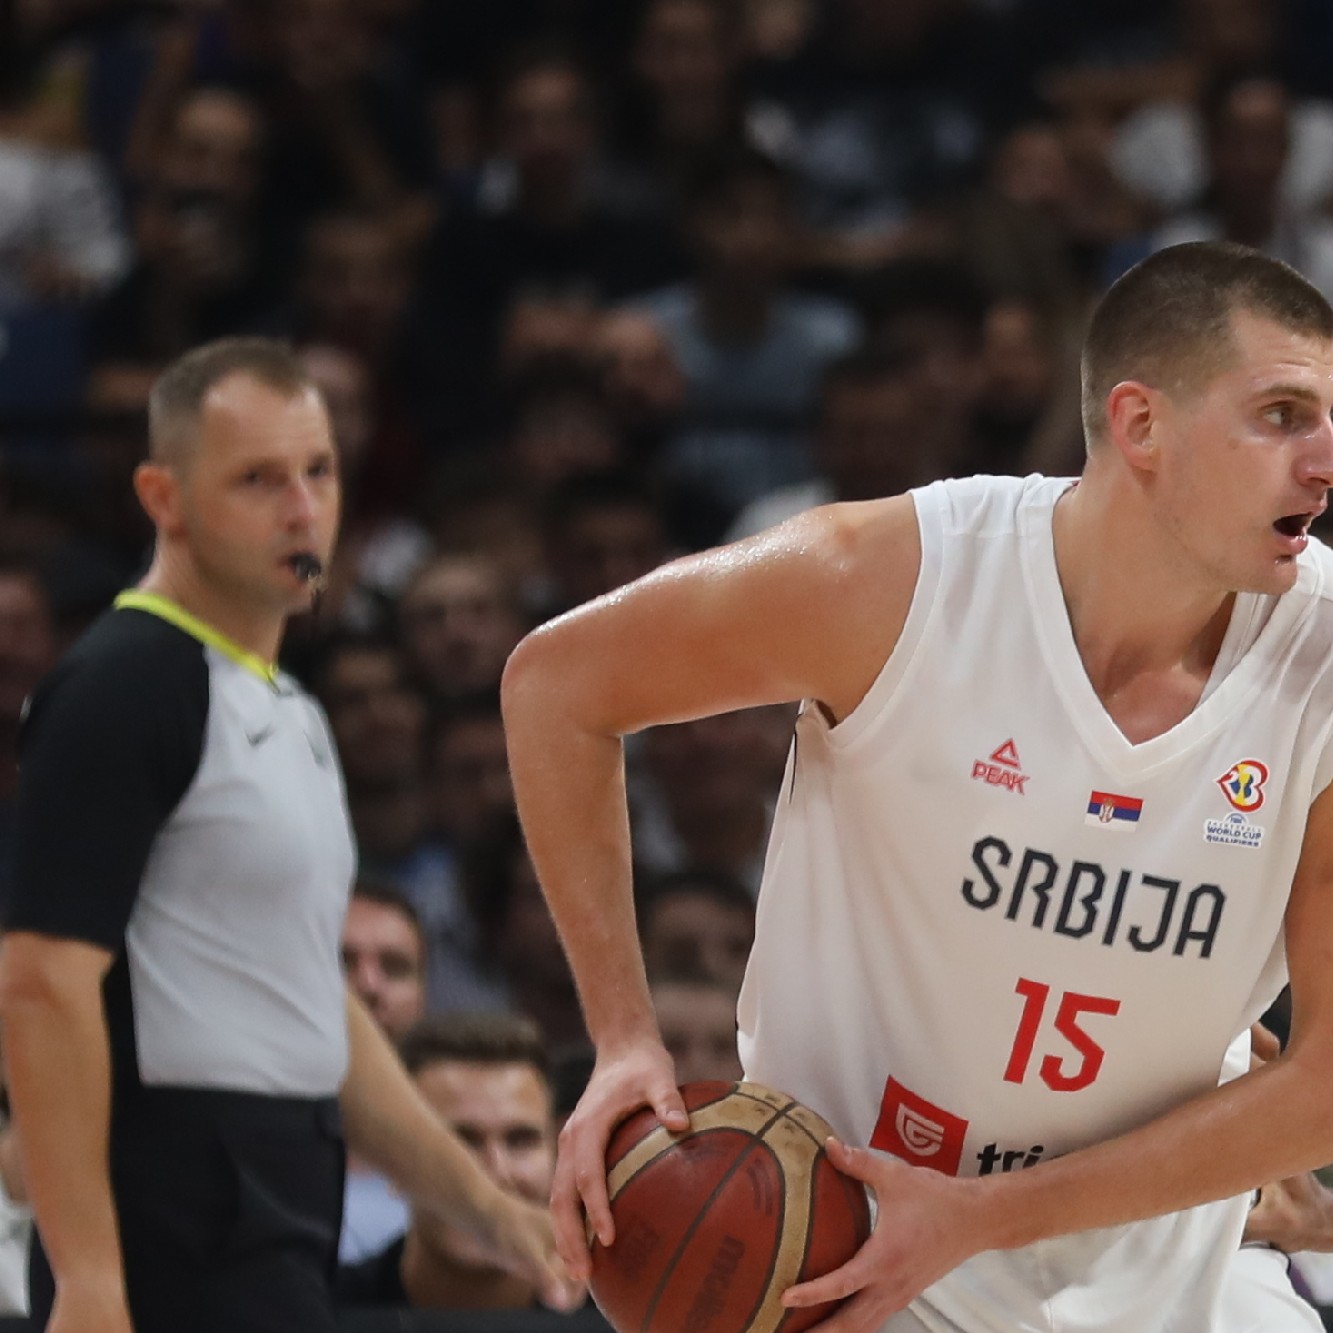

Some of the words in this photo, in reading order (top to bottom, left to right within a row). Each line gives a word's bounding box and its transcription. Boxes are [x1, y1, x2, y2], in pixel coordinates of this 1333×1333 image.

[971, 760, 1030, 796] PEAK
[1207, 826, 1241, 838] WORLD
[1242, 831, 1262, 840] CUP
[961, 835, 1226, 959] SRBIJA
[1003, 977, 1121, 1092] 15
